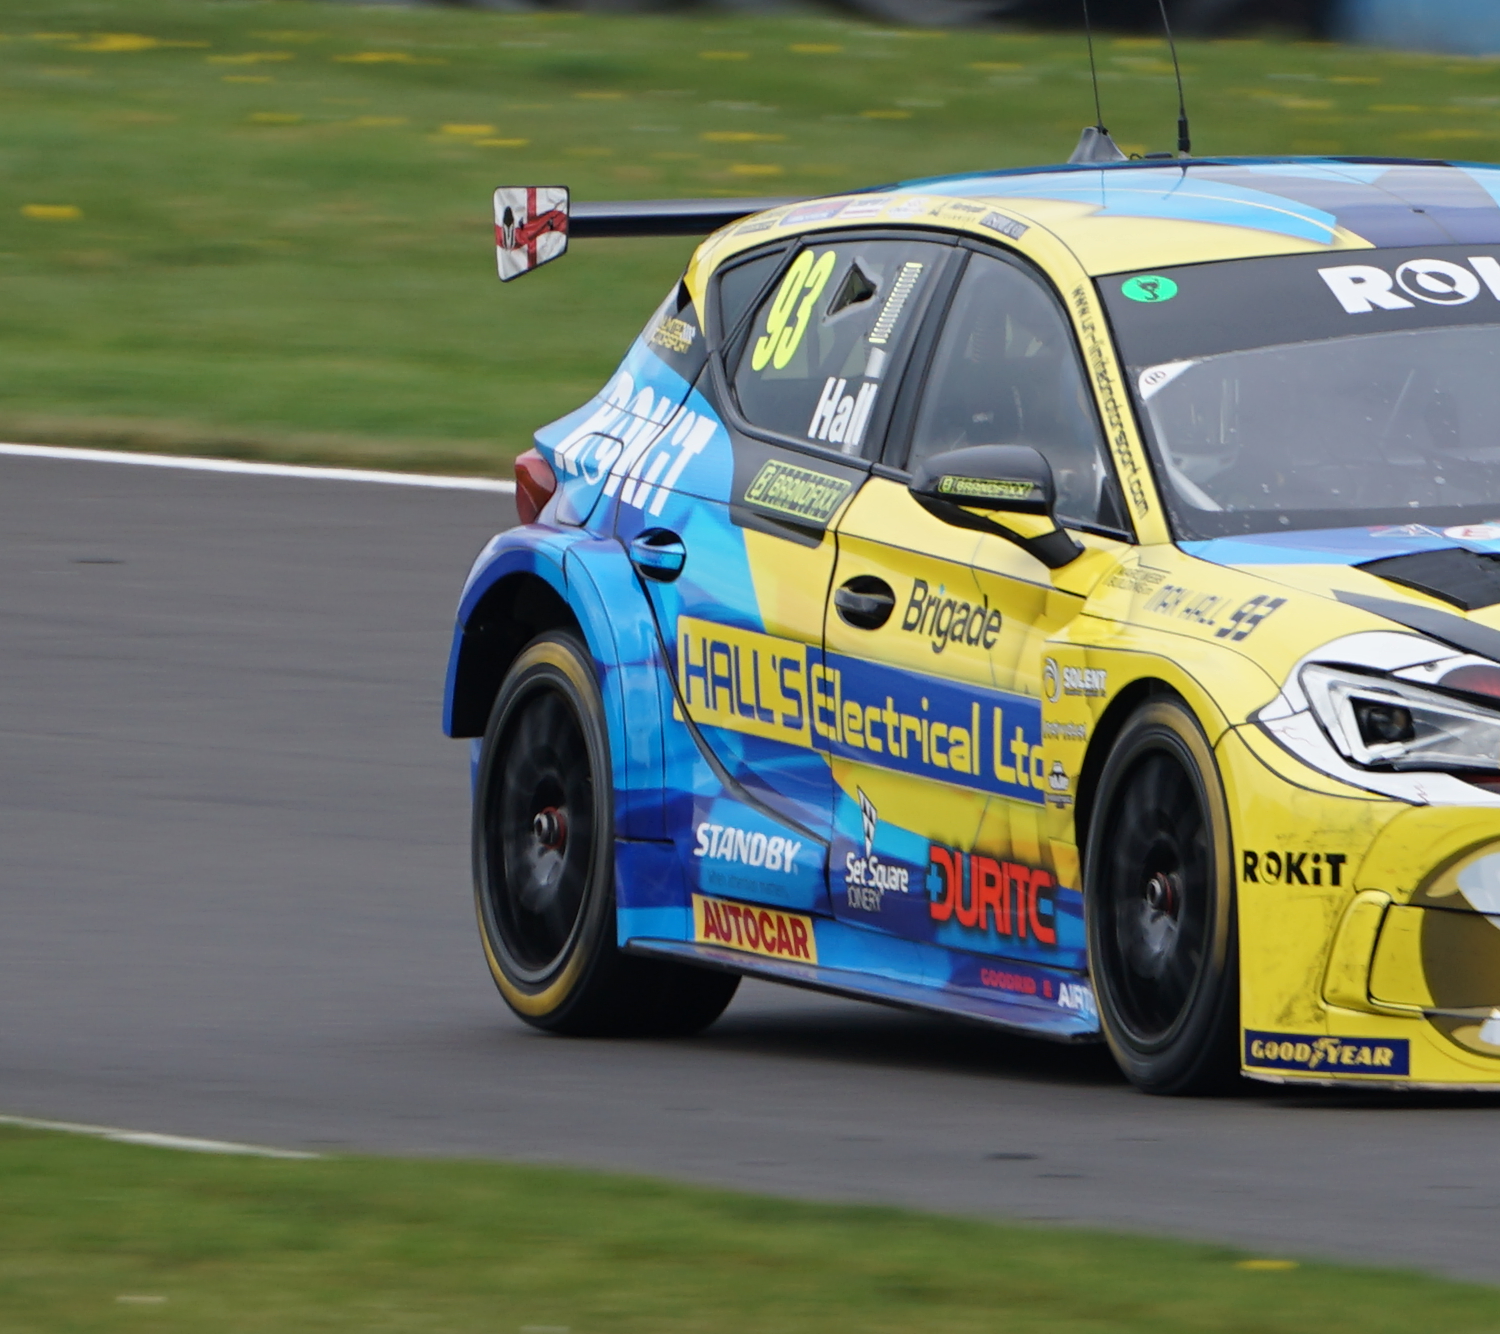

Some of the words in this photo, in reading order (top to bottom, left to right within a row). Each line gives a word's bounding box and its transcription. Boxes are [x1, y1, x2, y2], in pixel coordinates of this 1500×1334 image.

[752, 250, 836, 371] 93
[807, 376, 878, 446] Hall
[902, 578, 1002, 654] Brigade
[684, 633, 805, 731] HALL'S
[811, 662, 981, 776] Electrical
[1063, 667, 1108, 691] SOLENT
[694, 823, 802, 875] STANDBY
[845, 852, 867, 885] Set
[867, 856, 909, 894] Square
[1243, 849, 1348, 887] ROKiT
[703, 899, 811, 960] AUTOCAR
[1251, 1038, 1395, 1068] GOODYEAR
